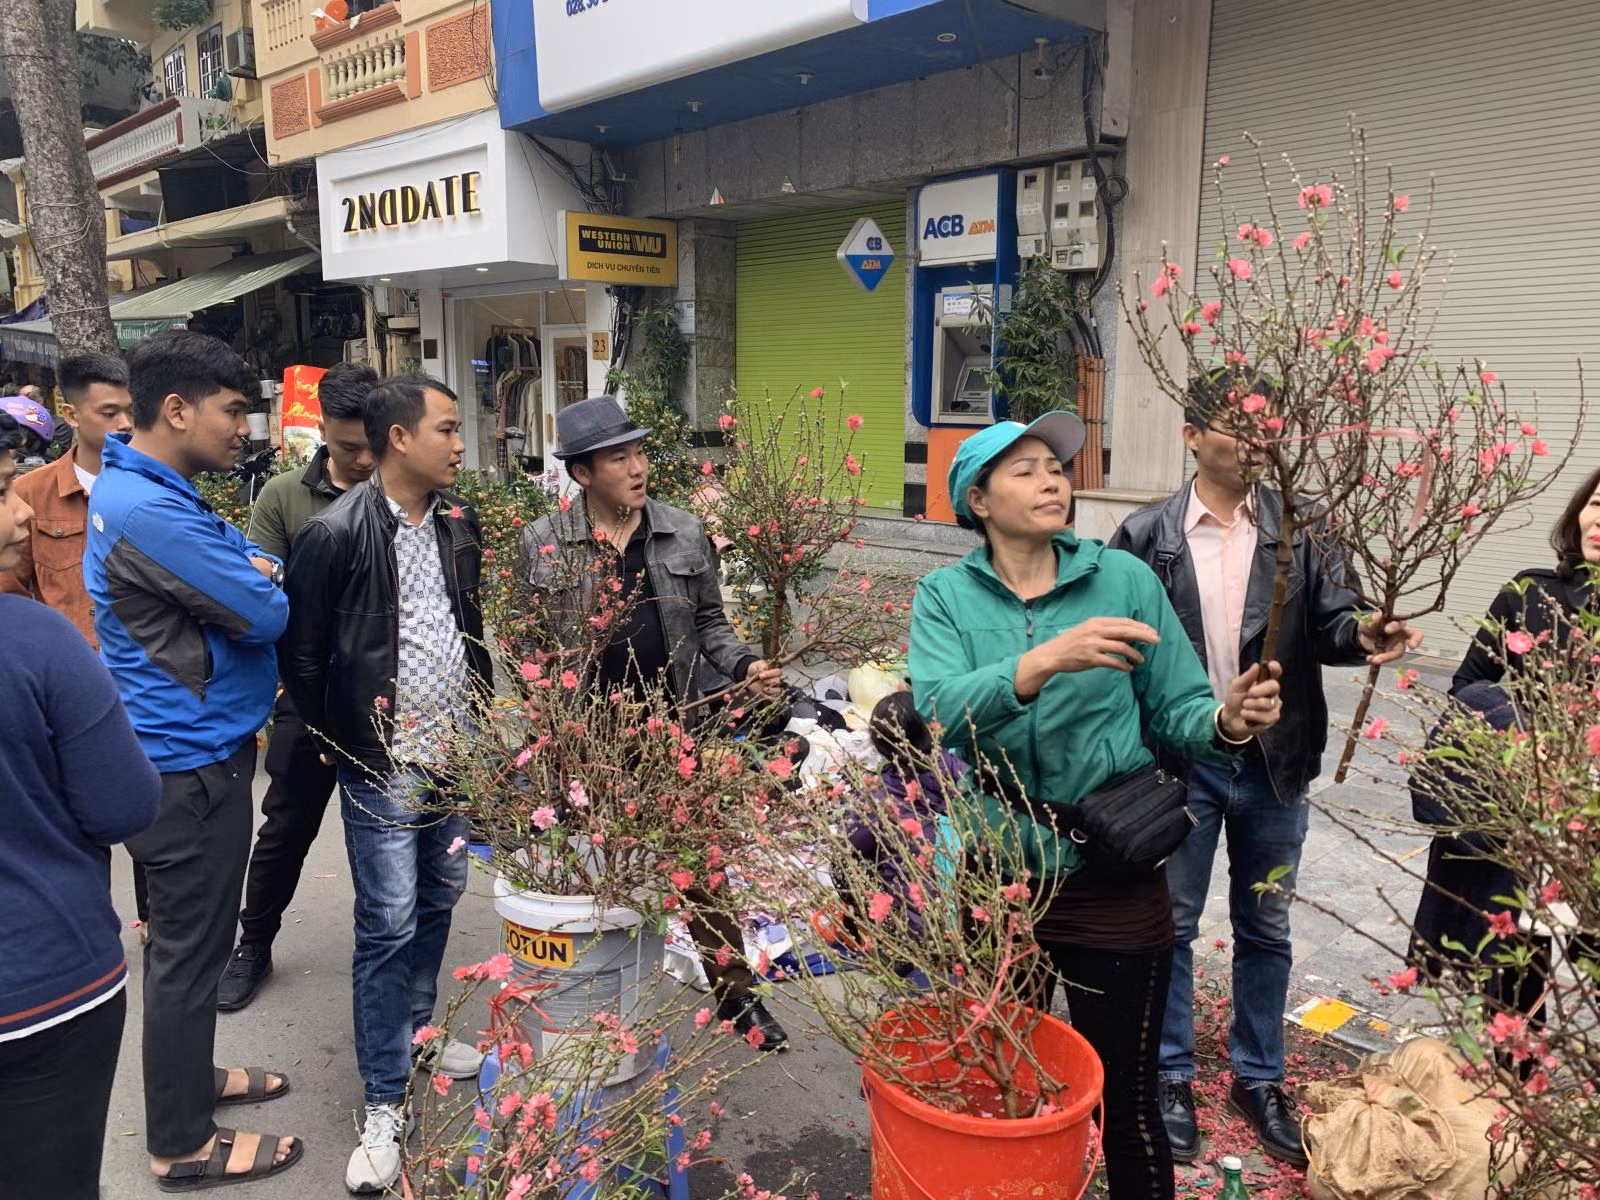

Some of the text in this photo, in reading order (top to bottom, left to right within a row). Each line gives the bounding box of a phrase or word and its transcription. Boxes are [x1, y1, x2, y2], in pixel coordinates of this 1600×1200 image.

[923, 214, 995, 240] ACB ATM
[581, 229, 630, 242] WESTERN
[597, 240, 631, 251] UNION
[635, 235, 662, 253] WU
[861, 259, 881, 270] ATM
[593, 339, 606, 353] 23
